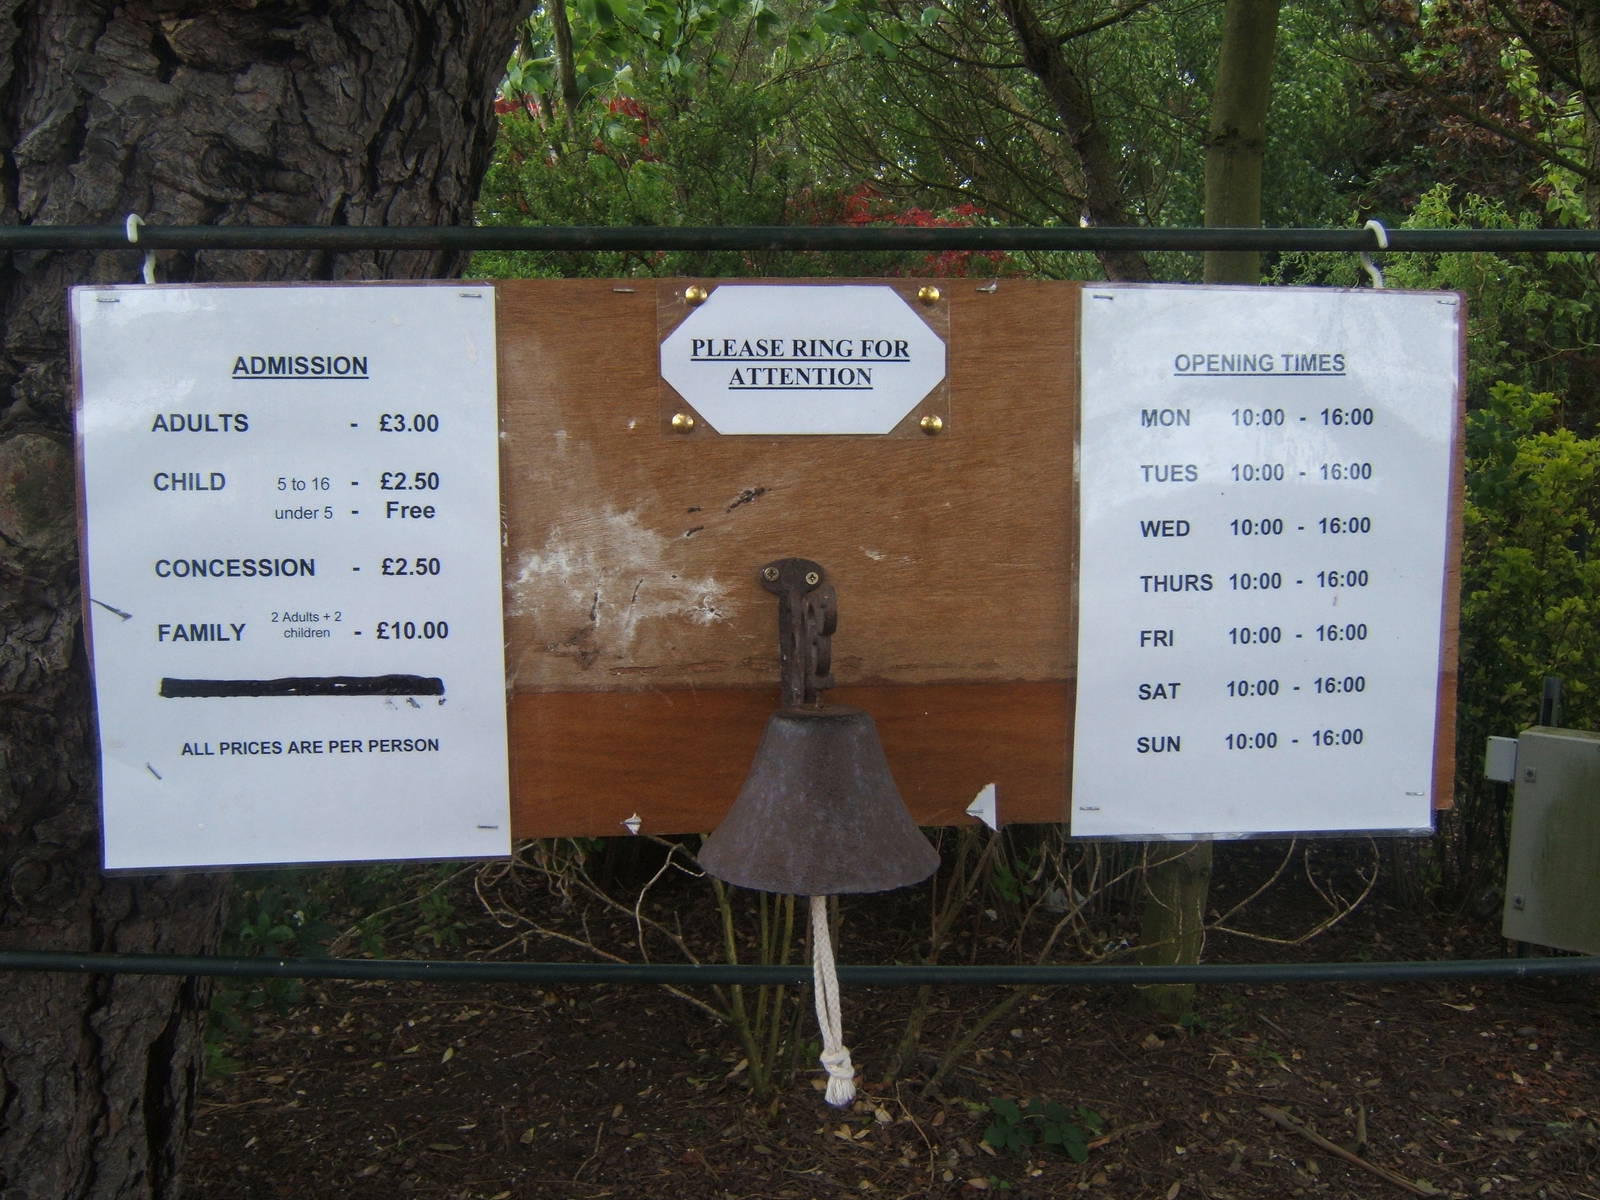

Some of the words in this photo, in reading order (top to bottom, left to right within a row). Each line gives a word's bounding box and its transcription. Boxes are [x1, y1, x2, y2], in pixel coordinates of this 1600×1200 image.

[691, 338, 785, 358] PLEASE
[792, 339, 853, 358] RING
[860, 339, 910, 358] FOR
[232, 356, 368, 375] ADMISSION
[1174, 353, 1274, 373] OPENING
[1281, 353, 1346, 372] TIMES
[729, 367, 872, 386] ATTENTION
[151, 413, 249, 433] ADULTS
[379, 413, 439, 433] £3.00
[1141, 408, 1190, 428] MON
[1232, 408, 1285, 426] 10:00
[1320, 407, 1374, 426] 16:00
[153, 472, 226, 492] CHILD
[277, 477, 287, 491] 5
[291, 477, 306, 491] to
[312, 476, 330, 491] 16
[380, 471, 440, 491] £2.50
[1140, 464, 1198, 483] TUES
[1231, 463, 1284, 482] 10:00
[1320, 462, 1372, 481] 16:00
[275, 506, 319, 520] under
[324, 505, 333, 520] 5
[386, 501, 436, 519] Free
[1140, 519, 1191, 538] WED
[1230, 518, 1283, 536] 10:00
[1319, 516, 1371, 534] 16:00
[155, 558, 315, 578] CONCESSION
[381, 557, 441, 576] £2.50
[1139, 573, 1214, 593] THURS
[1229, 572, 1282, 591] 10:00
[1316, 569, 1369, 588] 16:00
[271, 611, 279, 623] 2
[282, 611, 320, 623] Adults
[334, 611, 342, 622] 2
[158, 623, 246, 642] FAMILY
[376, 621, 449, 640] £10.00
[283, 627, 331, 639] children
[1140, 629, 1174, 648] FRI
[1229, 626, 1282, 645] 10:00
[1316, 623, 1368, 642] 16:00
[1138, 682, 1181, 701] SAT
[1227, 679, 1280, 697] 10:00
[1314, 675, 1366, 694] 16:00
[181, 742, 215, 756] ALL
[219, 740, 283, 756] PRICES
[287, 740, 324, 755] ARE
[328, 739, 364, 754] PER
[368, 738, 439, 753] PERSON
[1136, 735, 1181, 754] SUN
[1225, 731, 1278, 750] 10:00
[1312, 728, 1364, 747] 16:00
